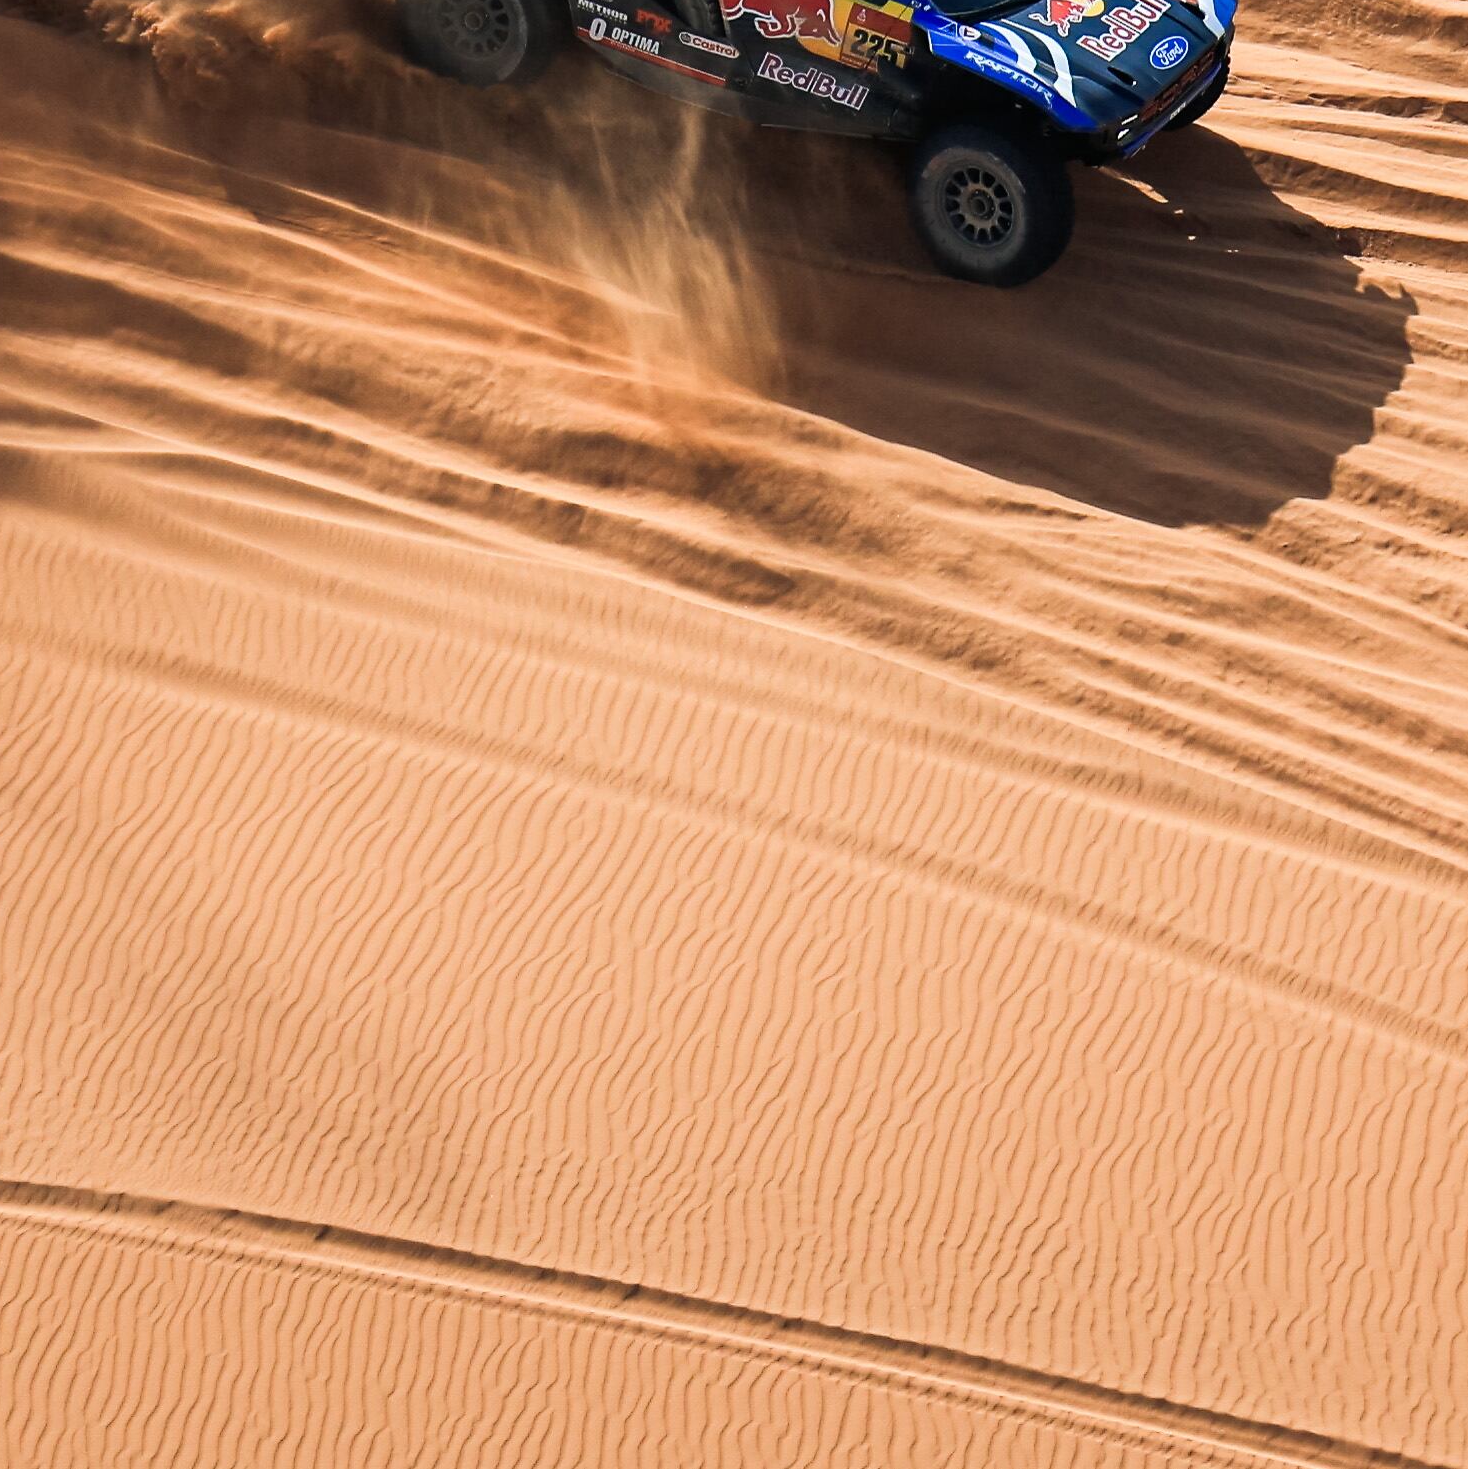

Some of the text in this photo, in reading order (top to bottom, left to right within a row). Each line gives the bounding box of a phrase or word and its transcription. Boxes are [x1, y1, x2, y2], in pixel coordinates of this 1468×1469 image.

[611, 27, 660, 55] OPTIMA
[692, 38, 737, 57] Castrol
[851, 29, 906, 69] 225
[1155, 40, 1184, 66] Ford
[964, 51, 1053, 109] RAPTOR
